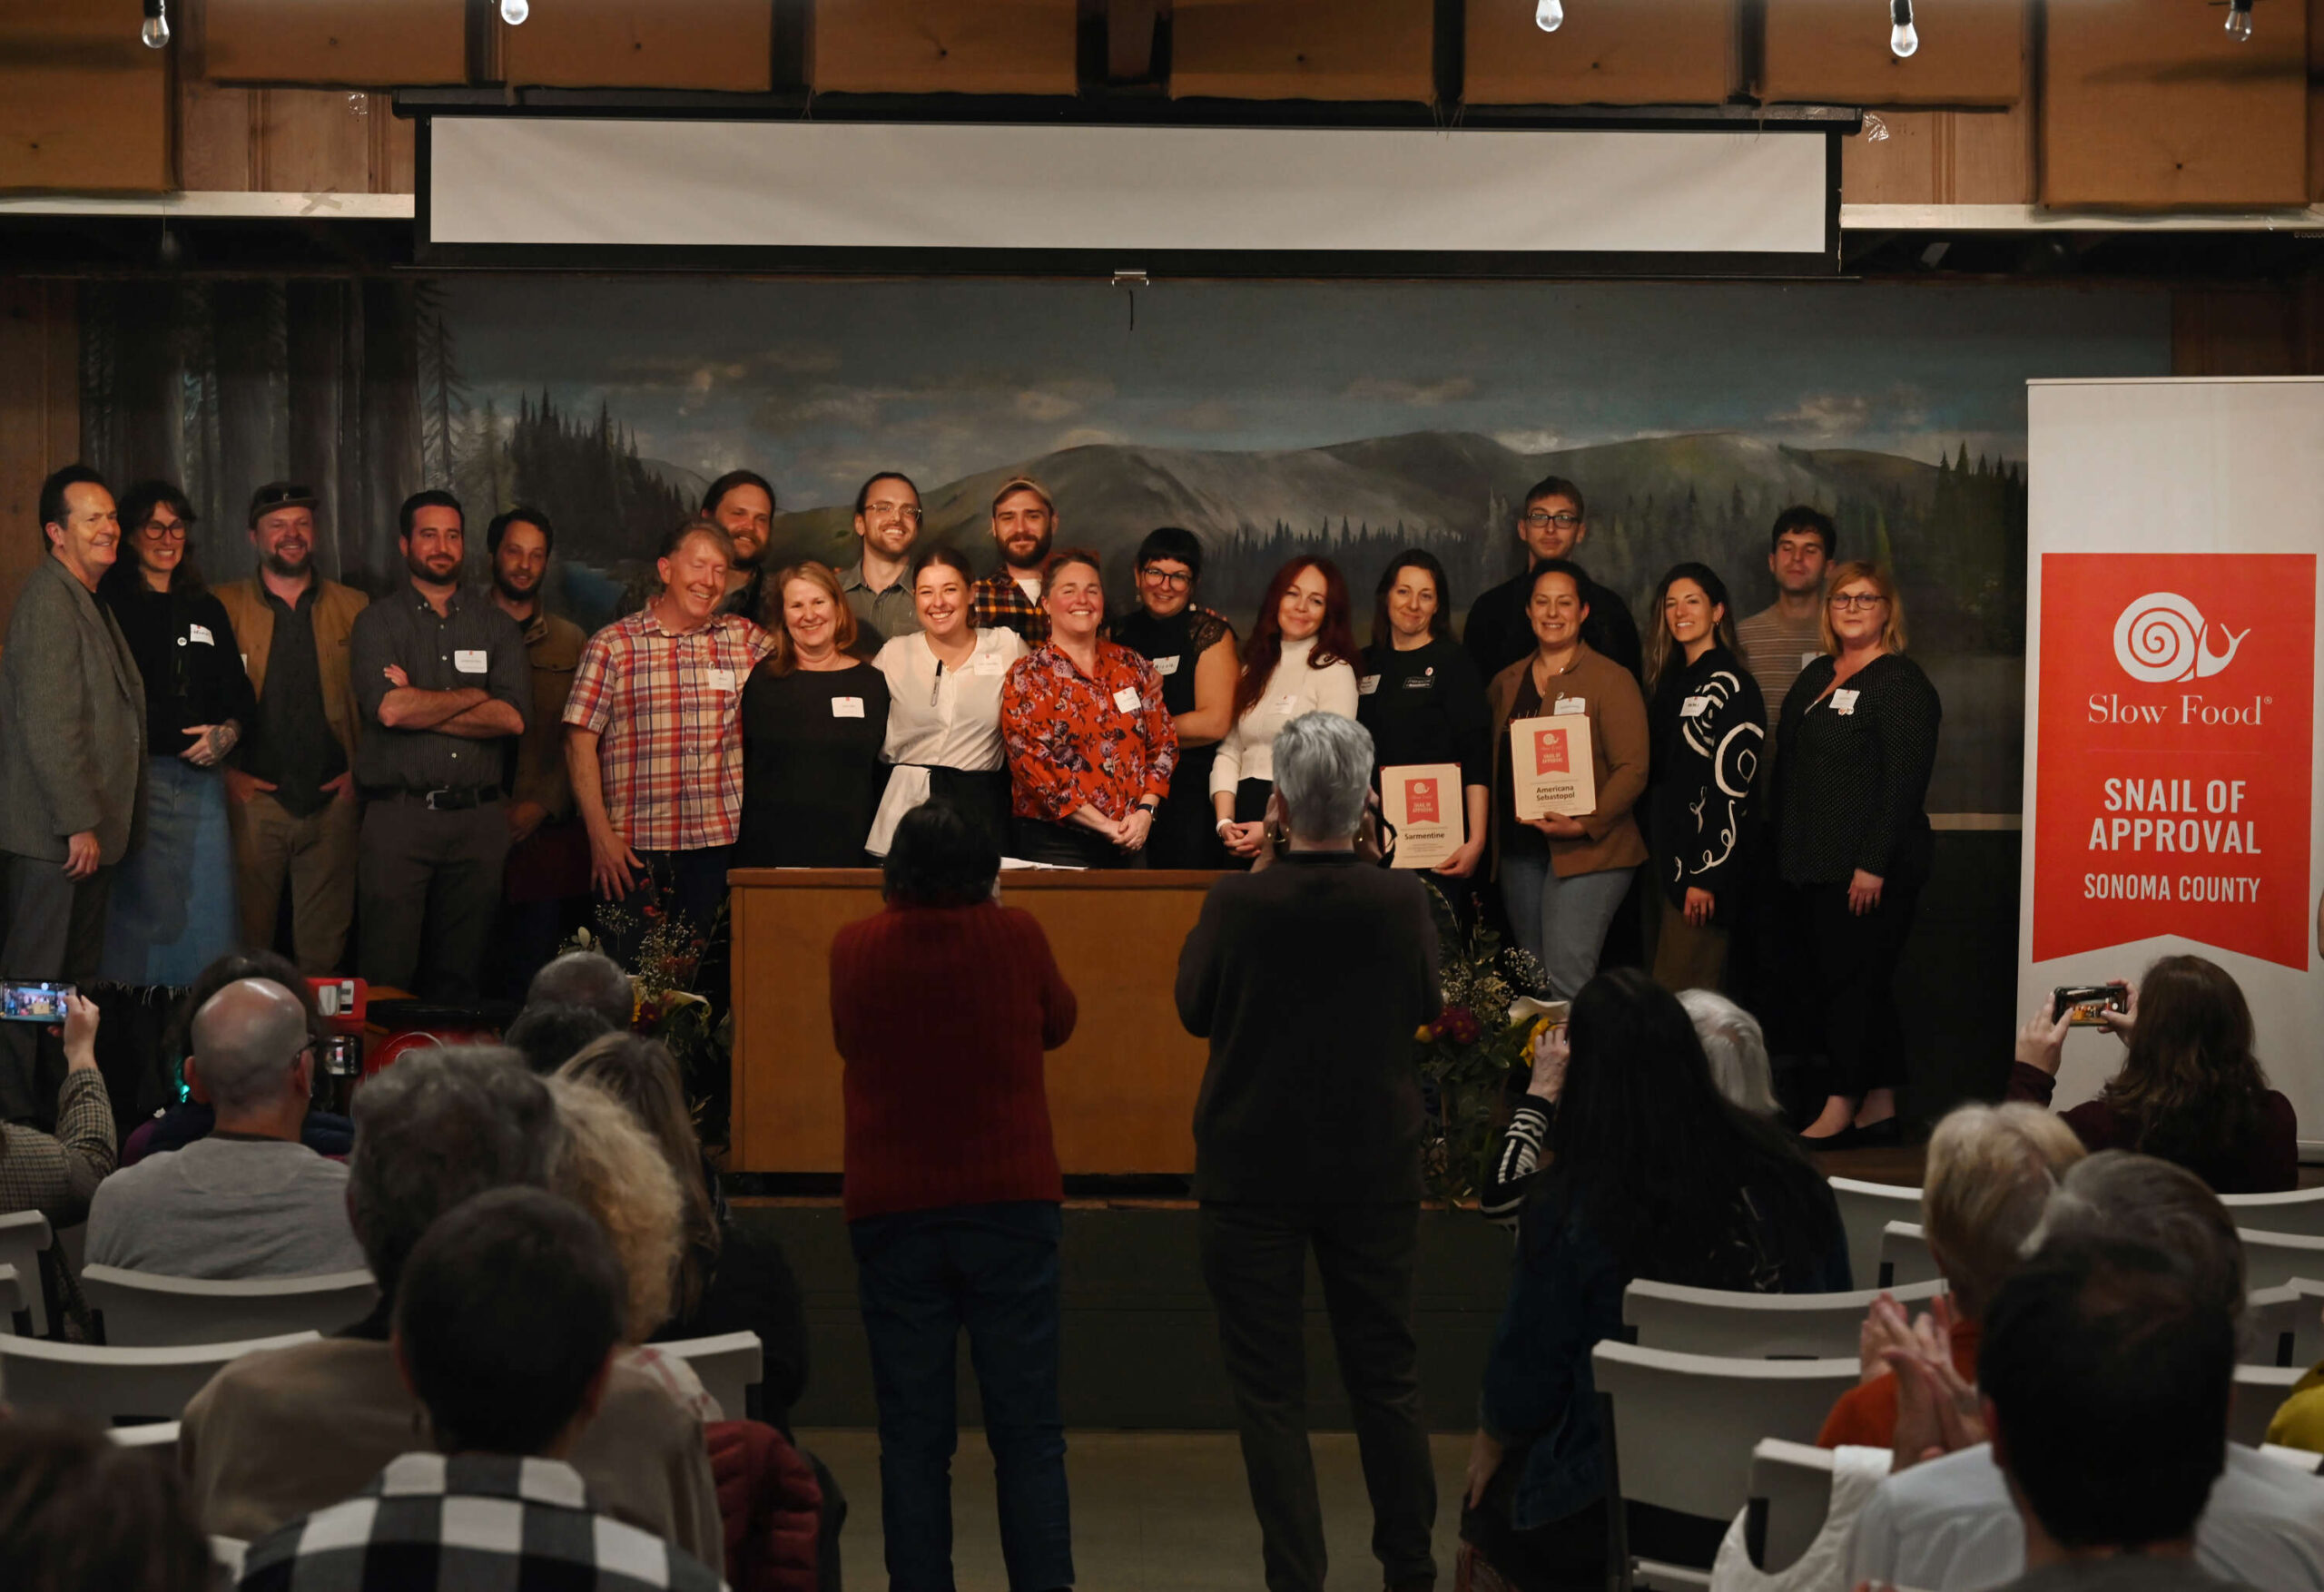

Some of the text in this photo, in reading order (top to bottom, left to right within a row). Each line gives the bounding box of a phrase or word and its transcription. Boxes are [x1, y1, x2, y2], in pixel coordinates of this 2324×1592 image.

[2088, 693, 2168, 724] Slow
[1536, 784, 1574, 794] Americana
[1536, 791, 1575, 801] Sebastopol
[2103, 777, 2247, 814] SNAIL OF
[1404, 832, 1445, 840] Sarmentine
[2088, 817, 2261, 855] APPROVAL
[2083, 872, 2261, 904] SONOMA COUNTY
